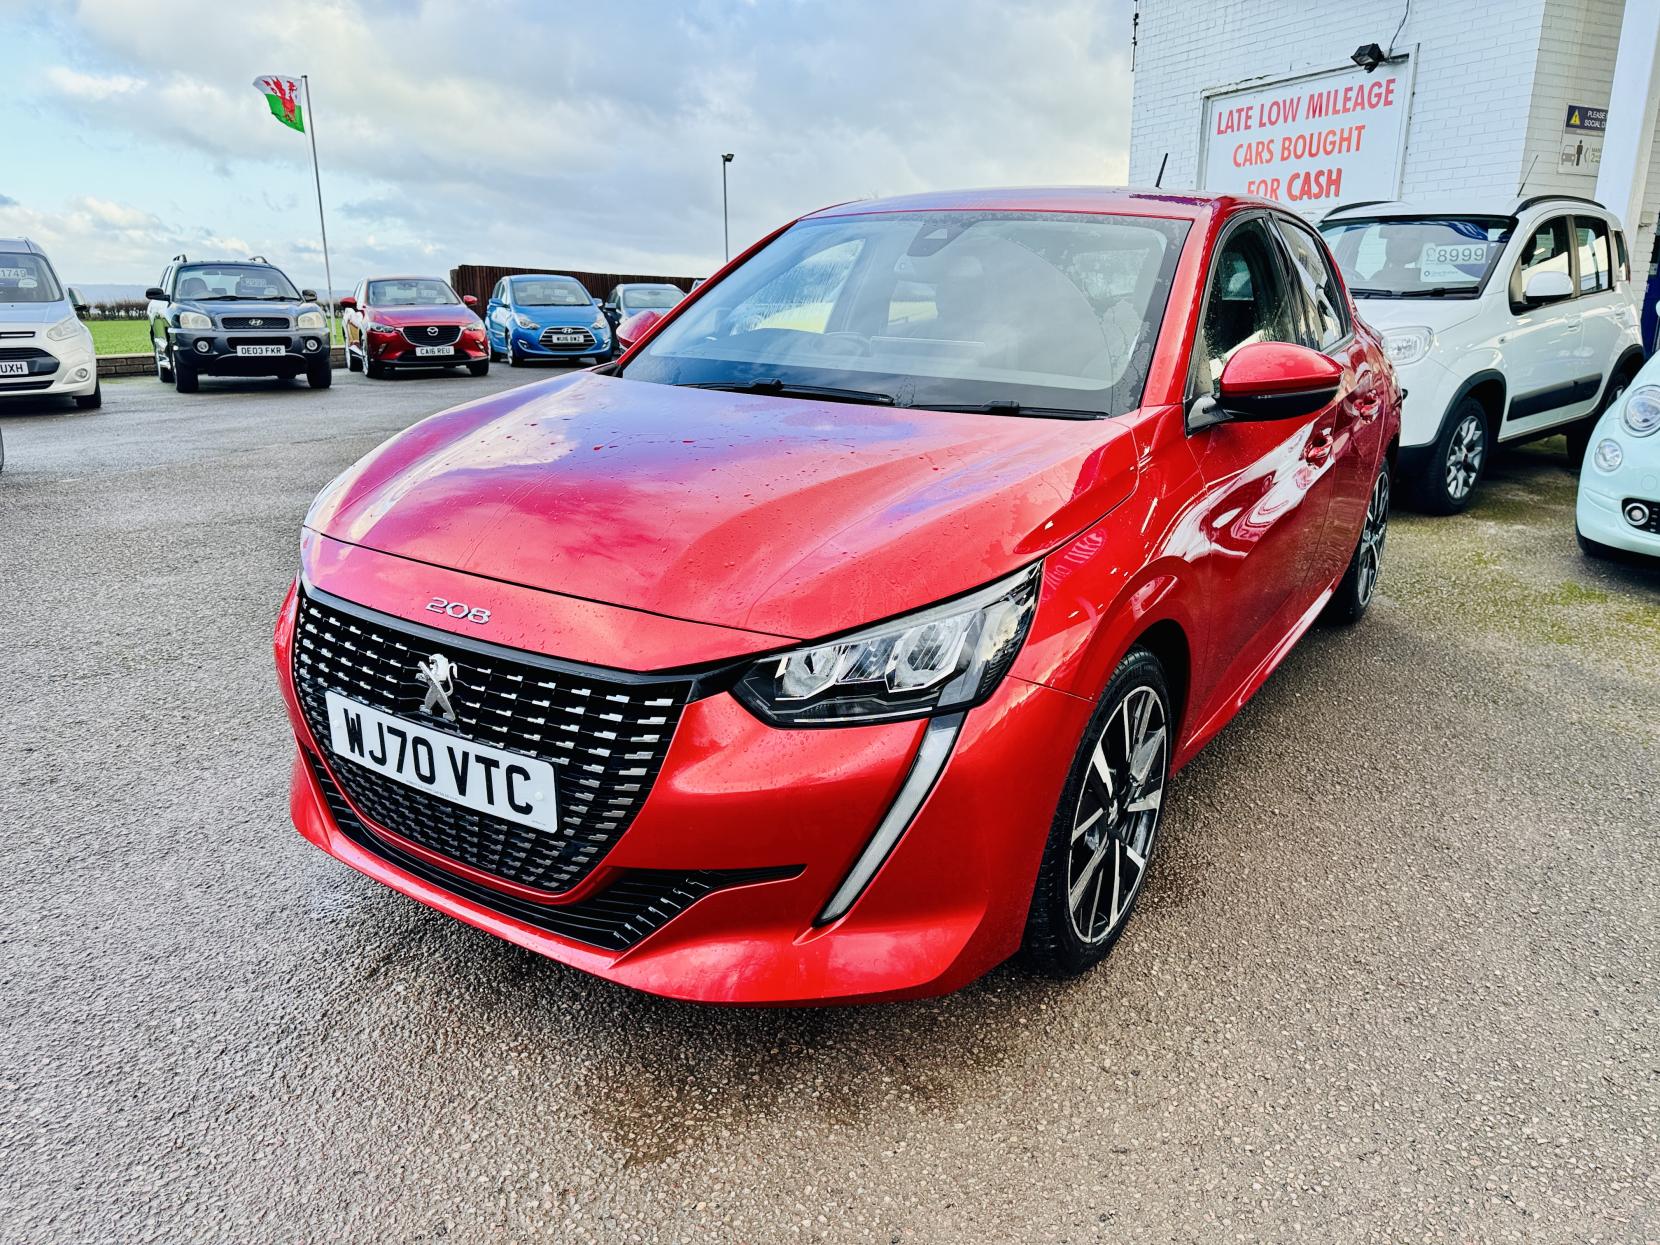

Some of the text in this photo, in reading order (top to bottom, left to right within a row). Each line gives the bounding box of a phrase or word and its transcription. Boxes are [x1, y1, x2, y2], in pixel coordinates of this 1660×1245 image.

[1217, 78, 1396, 135] LATE LOW MILEAGE
[1587, 110, 1606, 119] PLEASE
[1233, 124, 1366, 168] CARS BOUGHT
[1247, 168, 1342, 202] FOR CASH
[265, 347, 282, 355] FKR
[0, 363, 23, 373] UXH
[425, 597, 492, 625] 208
[343, 707, 534, 816] WJ70 VTC
